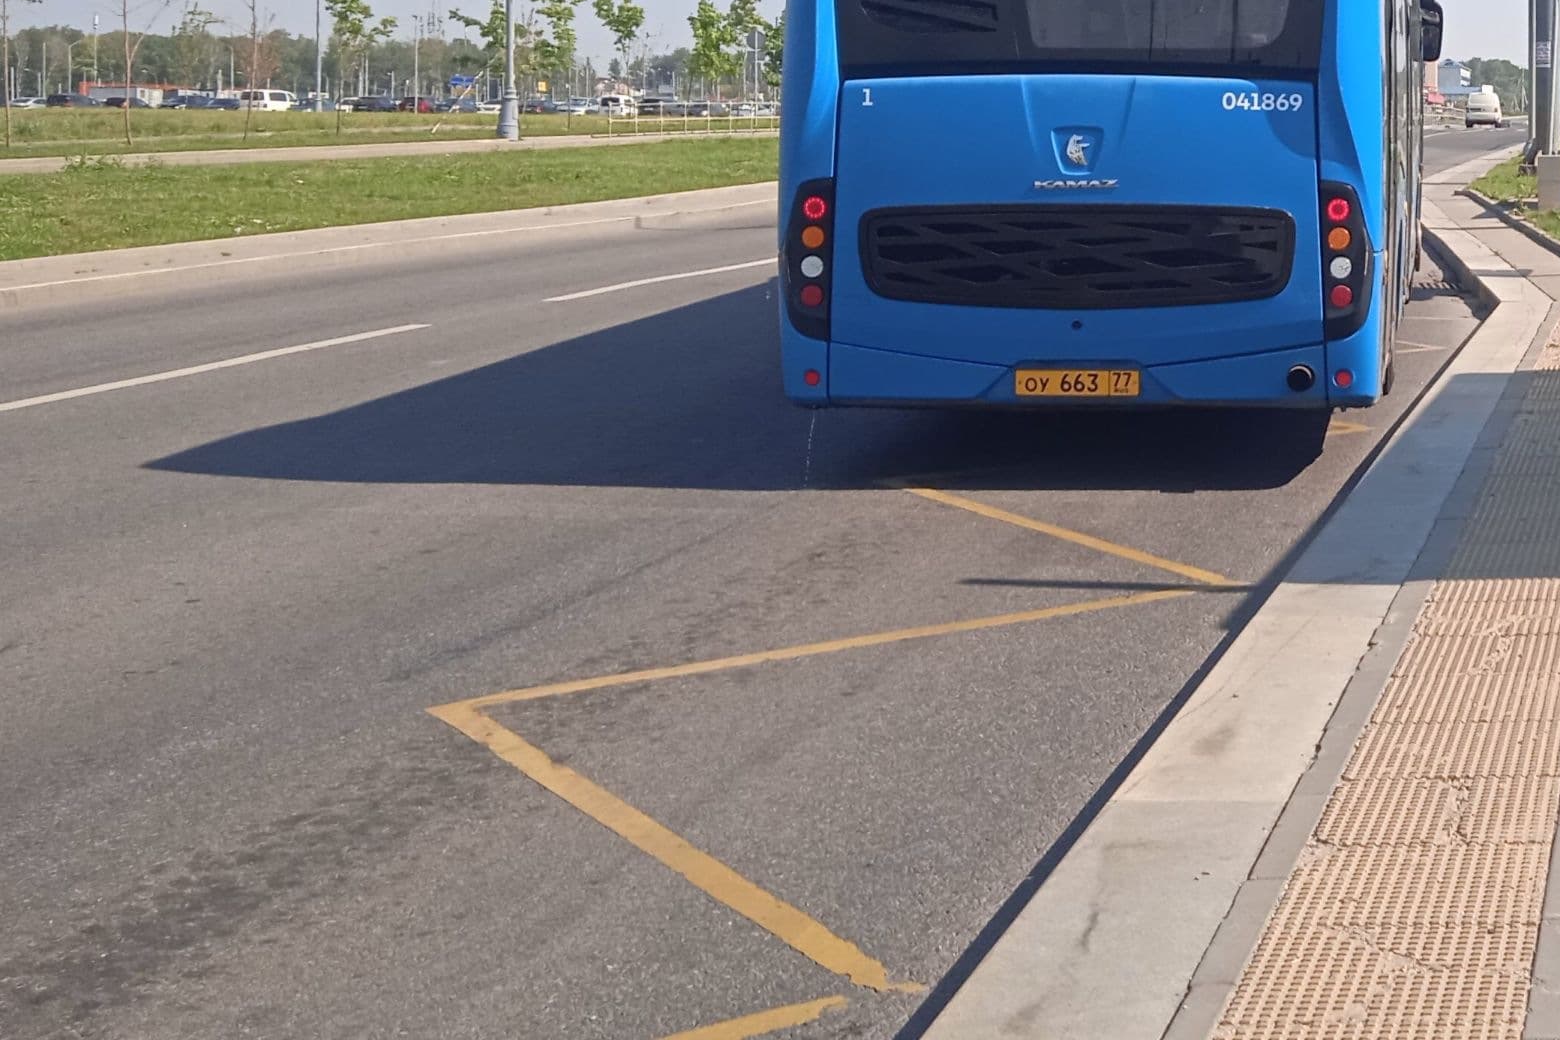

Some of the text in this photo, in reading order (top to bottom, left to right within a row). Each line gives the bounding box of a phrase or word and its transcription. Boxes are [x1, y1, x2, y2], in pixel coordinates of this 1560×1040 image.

[862, 88, 873, 106] 1
[1222, 92, 1303, 111] 041869
[1034, 179, 1119, 189] KAMAZ
[1060, 373, 1099, 392] 663
[1113, 372, 1132, 387] 77
